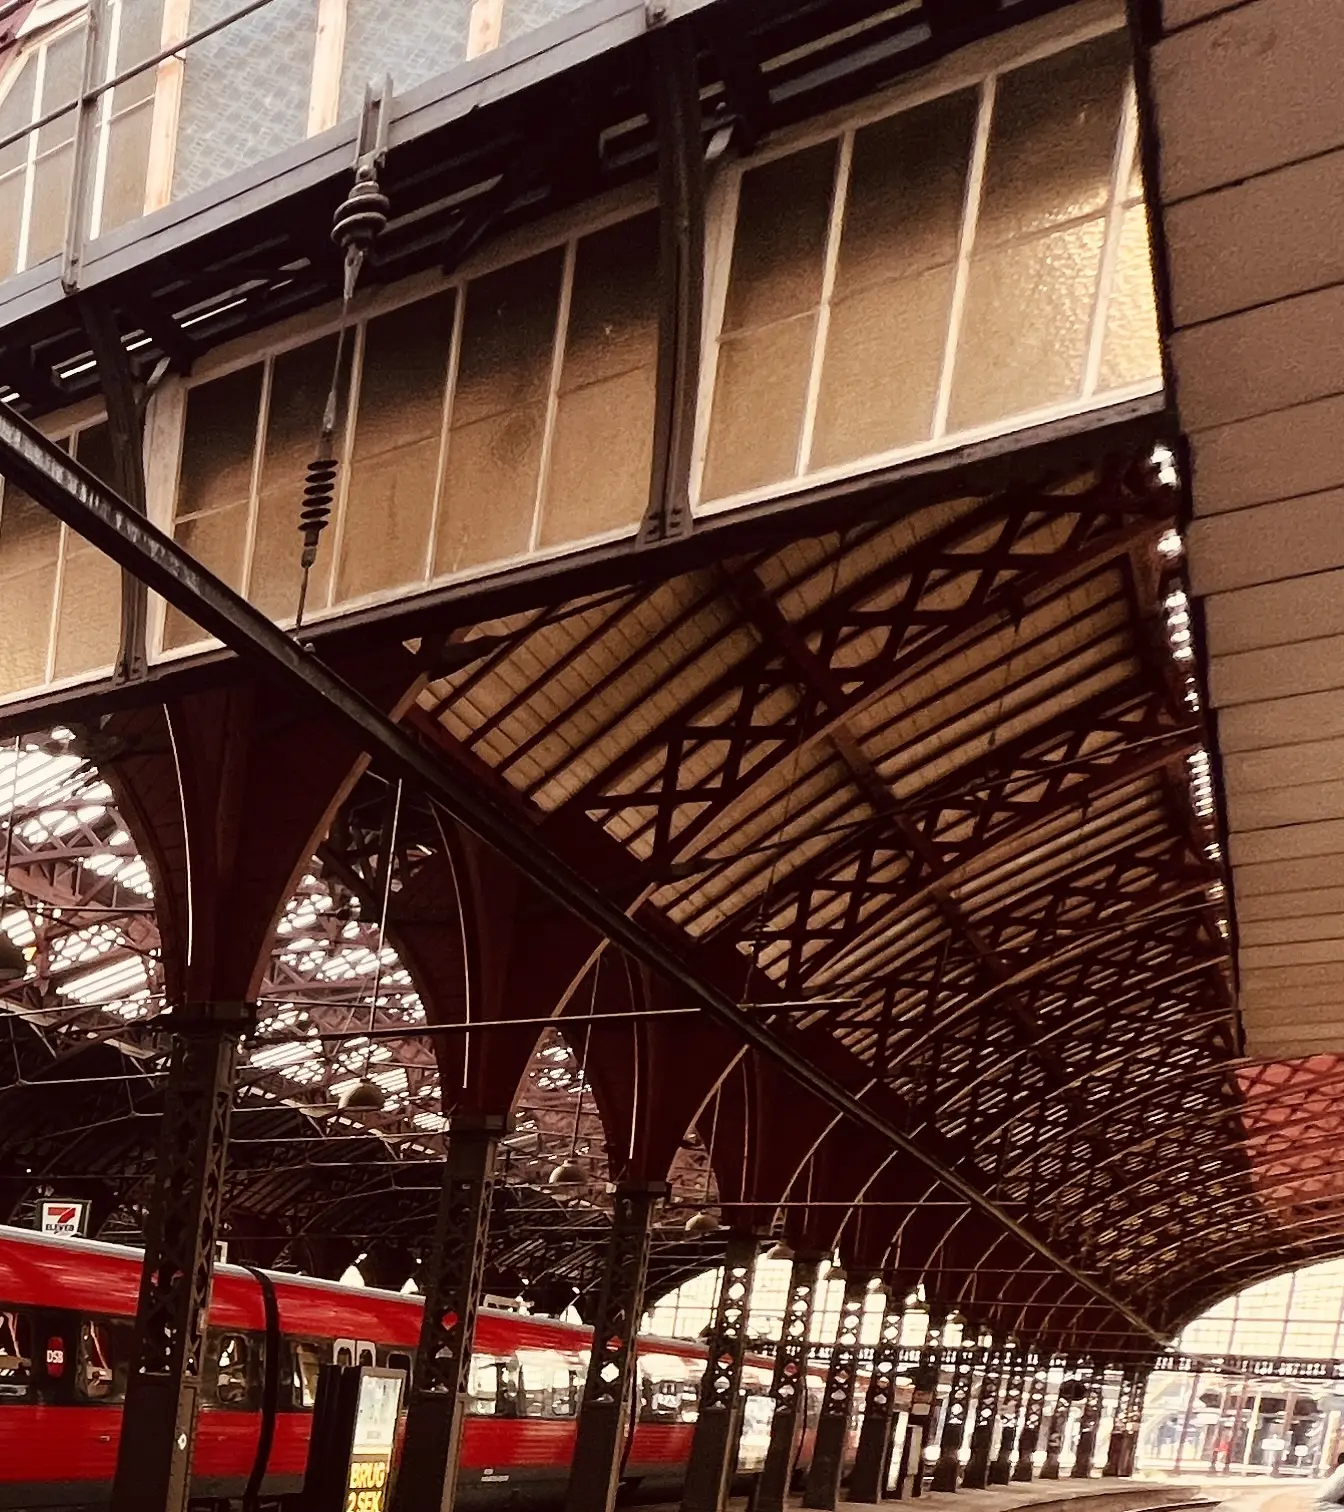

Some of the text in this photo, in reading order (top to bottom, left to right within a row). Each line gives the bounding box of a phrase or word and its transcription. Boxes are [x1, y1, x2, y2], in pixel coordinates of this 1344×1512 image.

[48, 1207, 76, 1223] 7
[47, 1349, 64, 1364] DSB
[349, 1461, 386, 1489] BRUG
